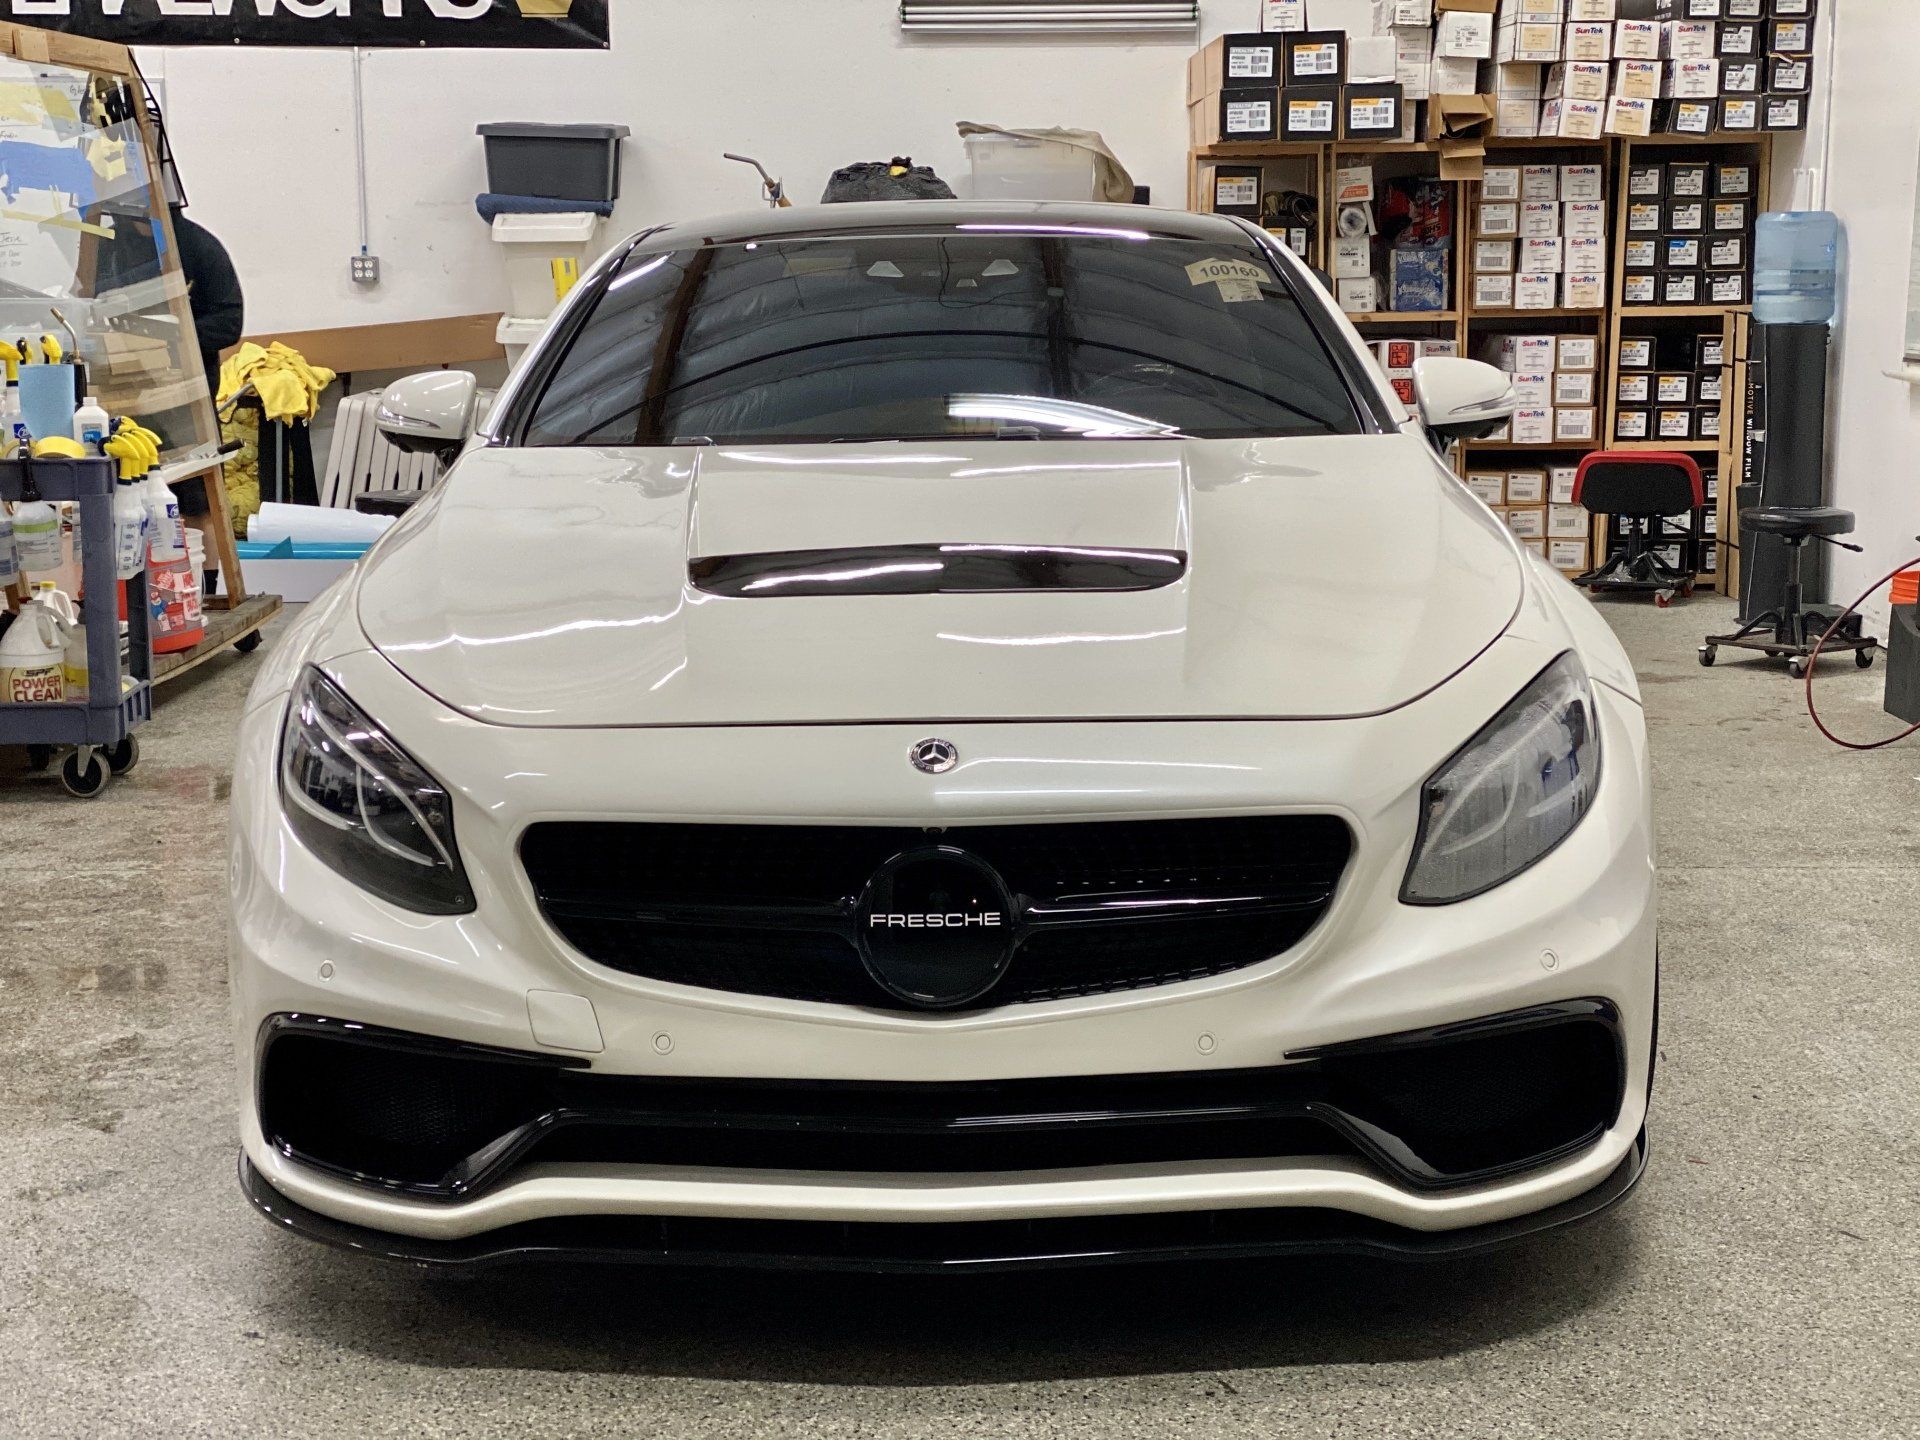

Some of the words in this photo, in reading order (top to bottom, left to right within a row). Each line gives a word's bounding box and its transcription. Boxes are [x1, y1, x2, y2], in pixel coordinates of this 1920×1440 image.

[1575, 26, 1604, 34] SunTek
[1624, 23, 1653, 32] SunTek
[1678, 24, 1706, 33] SunTek
[1573, 64, 1602, 73] SunTek
[1625, 63, 1654, 72] SunTek
[1616, 99, 1646, 109] SunTek
[1570, 105, 1598, 113] SunTek
[1525, 167, 1552, 175] SunTek
[1568, 167, 1596, 175] SunTek
[1200, 264, 1259, 278] 100160
[1425, 345, 1451, 353] SunTek
[1517, 375, 1545, 383] SunTek
[1518, 410, 1545, 418] SunTek
[13, 675, 61, 690] POWER
[14, 688, 62, 702] CLEAN
[870, 912, 1001, 928] FRESCHE
